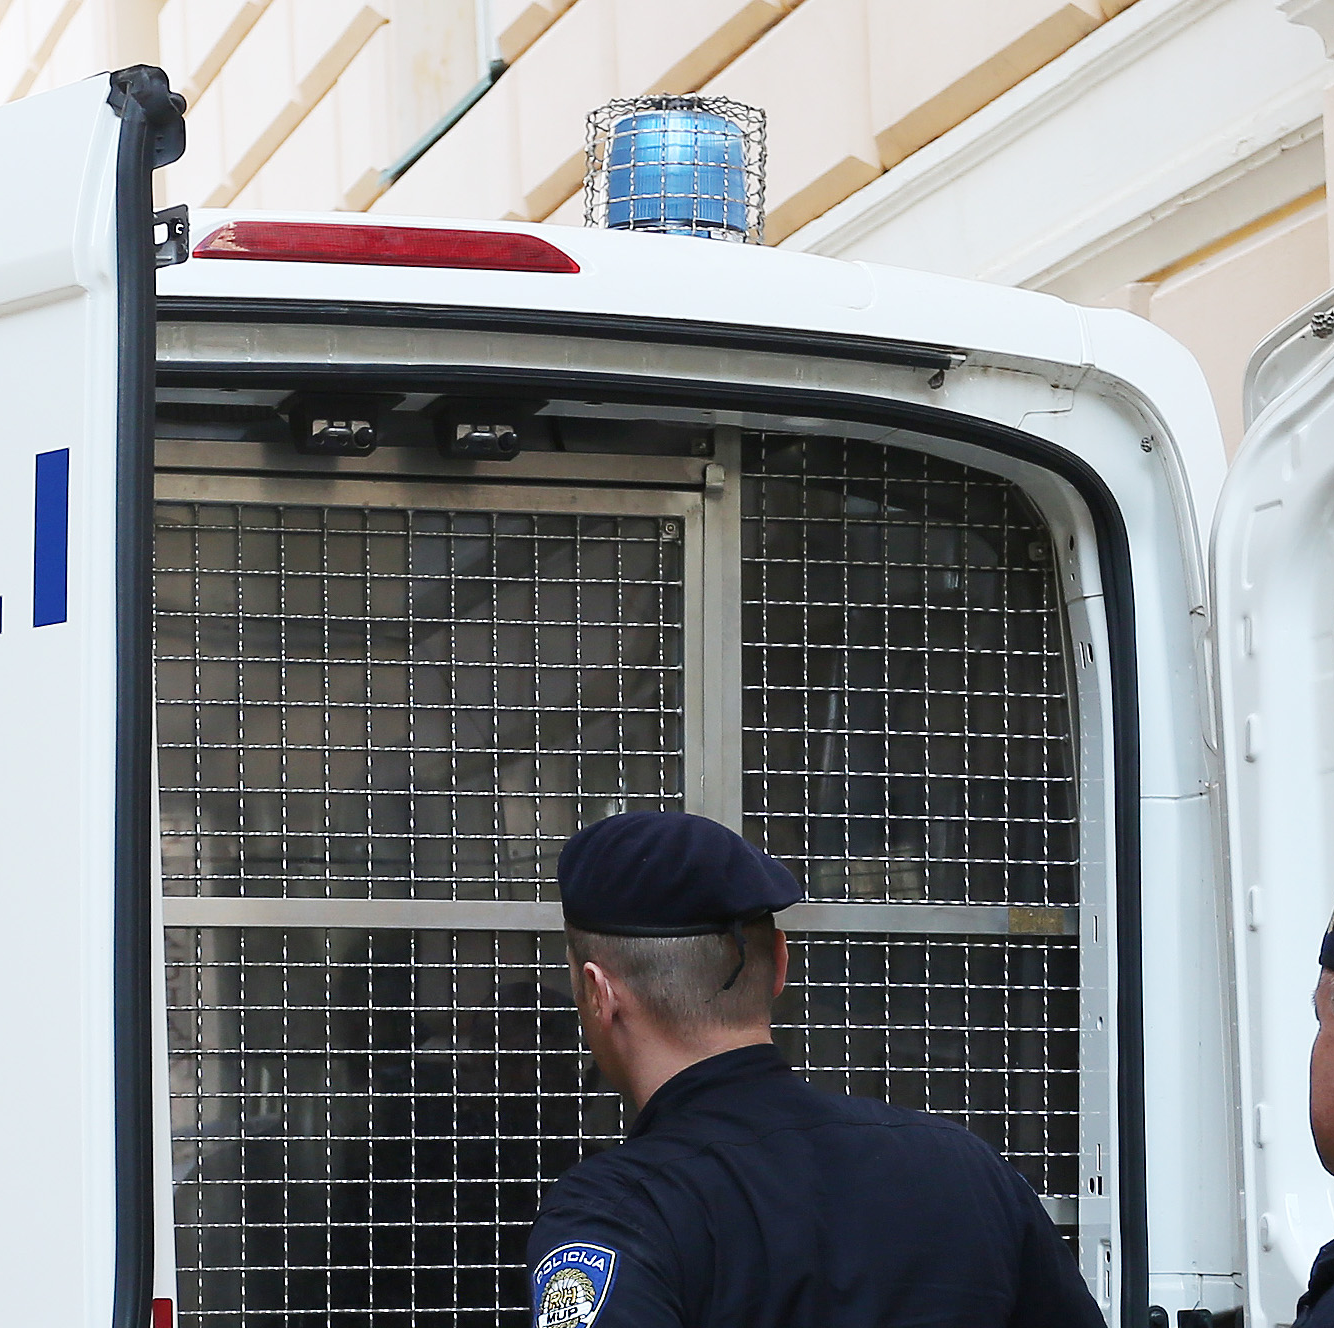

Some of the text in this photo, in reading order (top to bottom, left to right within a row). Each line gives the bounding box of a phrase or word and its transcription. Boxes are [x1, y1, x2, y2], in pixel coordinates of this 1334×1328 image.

[536, 1251, 605, 1285] POLICIJA
[548, 1287, 577, 1310] RH
[546, 1306, 578, 1325] MUP
